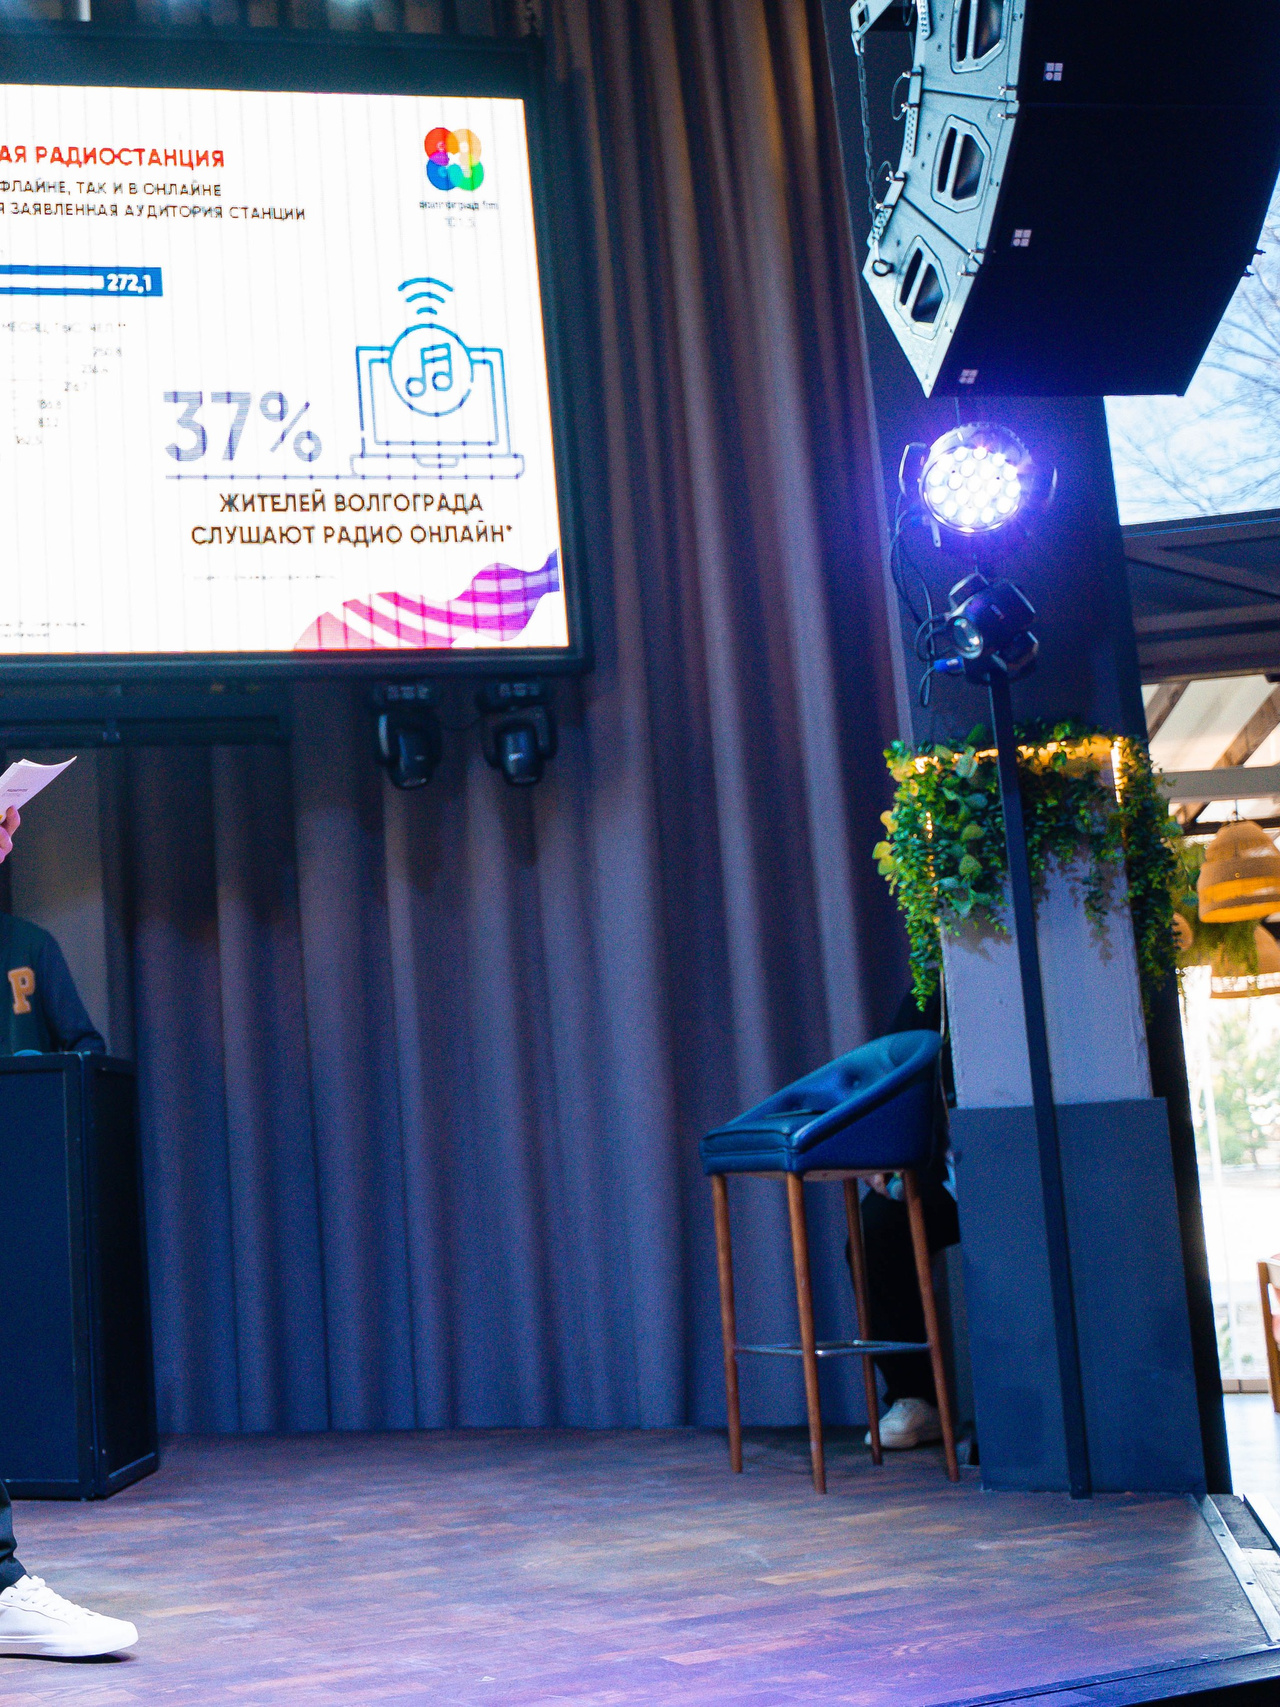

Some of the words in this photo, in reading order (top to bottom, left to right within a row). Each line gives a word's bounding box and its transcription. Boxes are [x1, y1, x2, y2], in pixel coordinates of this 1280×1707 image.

[35, 145, 225, 171] РАДИОСТАНЦИЯ
[75, 181, 107, 195] ТАК
[113, 182, 124, 195] И
[128, 183, 138, 196] В
[143, 181, 222, 197] ОНЛАЙНЕ
[10, 202, 118, 217] ЗАЯВЛЕННАЯ
[124, 204, 223, 220] АУДИТОРИЯ
[229, 206, 306, 221] СТАНЦИИ
[106, 273, 152, 294] 272,1
[163, 390, 323, 462] 37%
[219, 487, 326, 513] ЖИТЕЛЕЙ
[333, 492, 484, 515] ВОЛГОГРАДА
[190, 525, 316, 546] СЛУШАЮТ
[323, 525, 403, 549] РАДИО
[7, 965, 36, 1016] P
